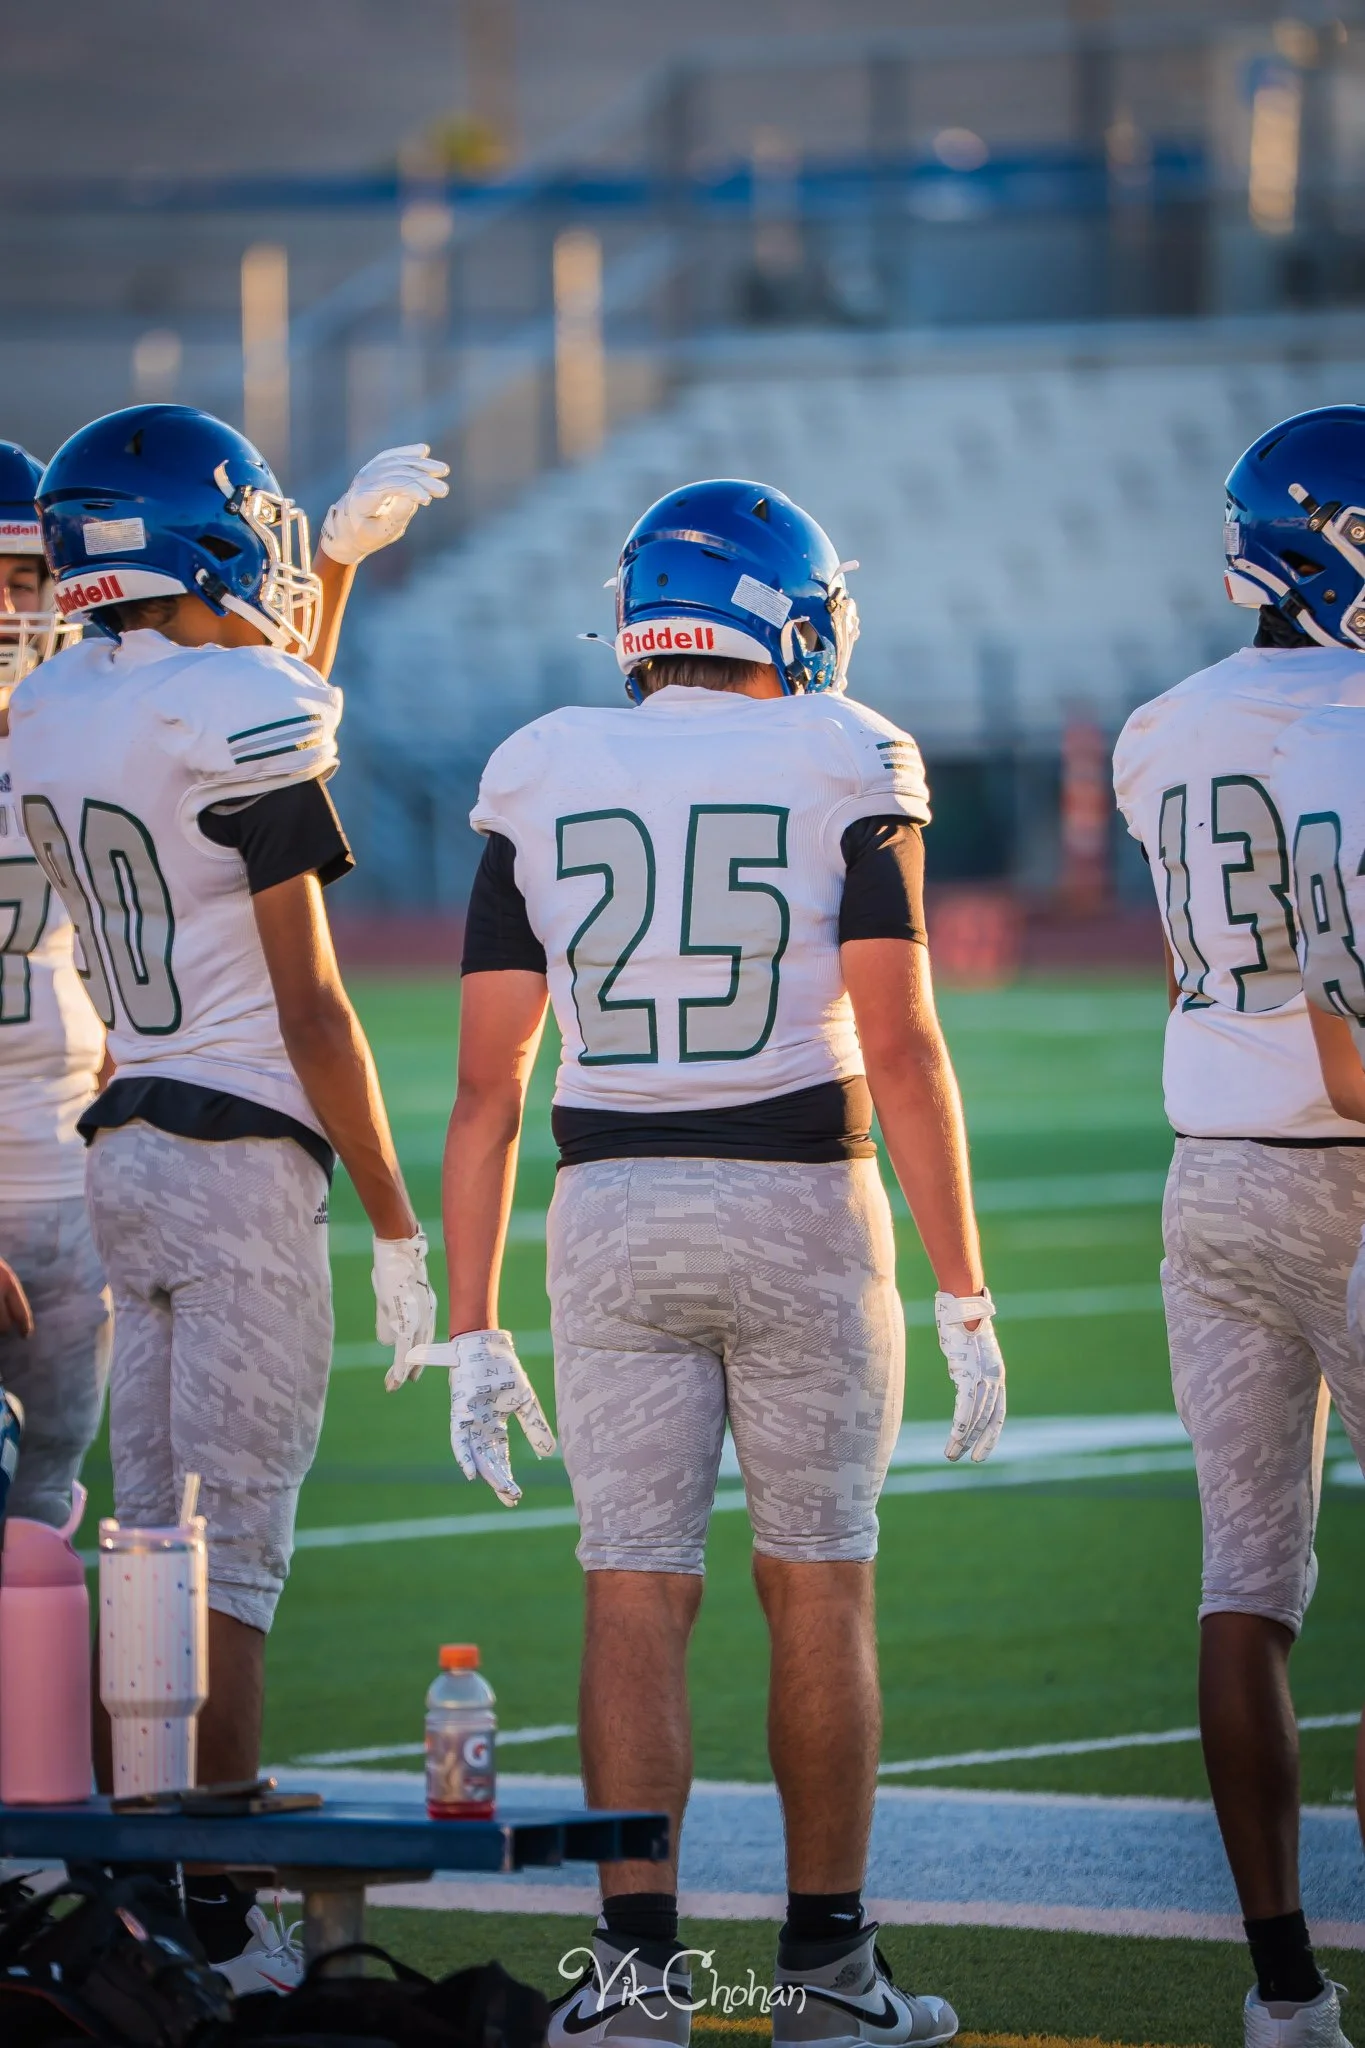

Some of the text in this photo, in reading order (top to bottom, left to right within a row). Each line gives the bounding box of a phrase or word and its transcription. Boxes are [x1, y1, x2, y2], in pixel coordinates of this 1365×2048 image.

[622, 627, 714, 655] Riddell
[555, 804, 790, 1066] 25
[1159, 774, 1301, 1013] 13
